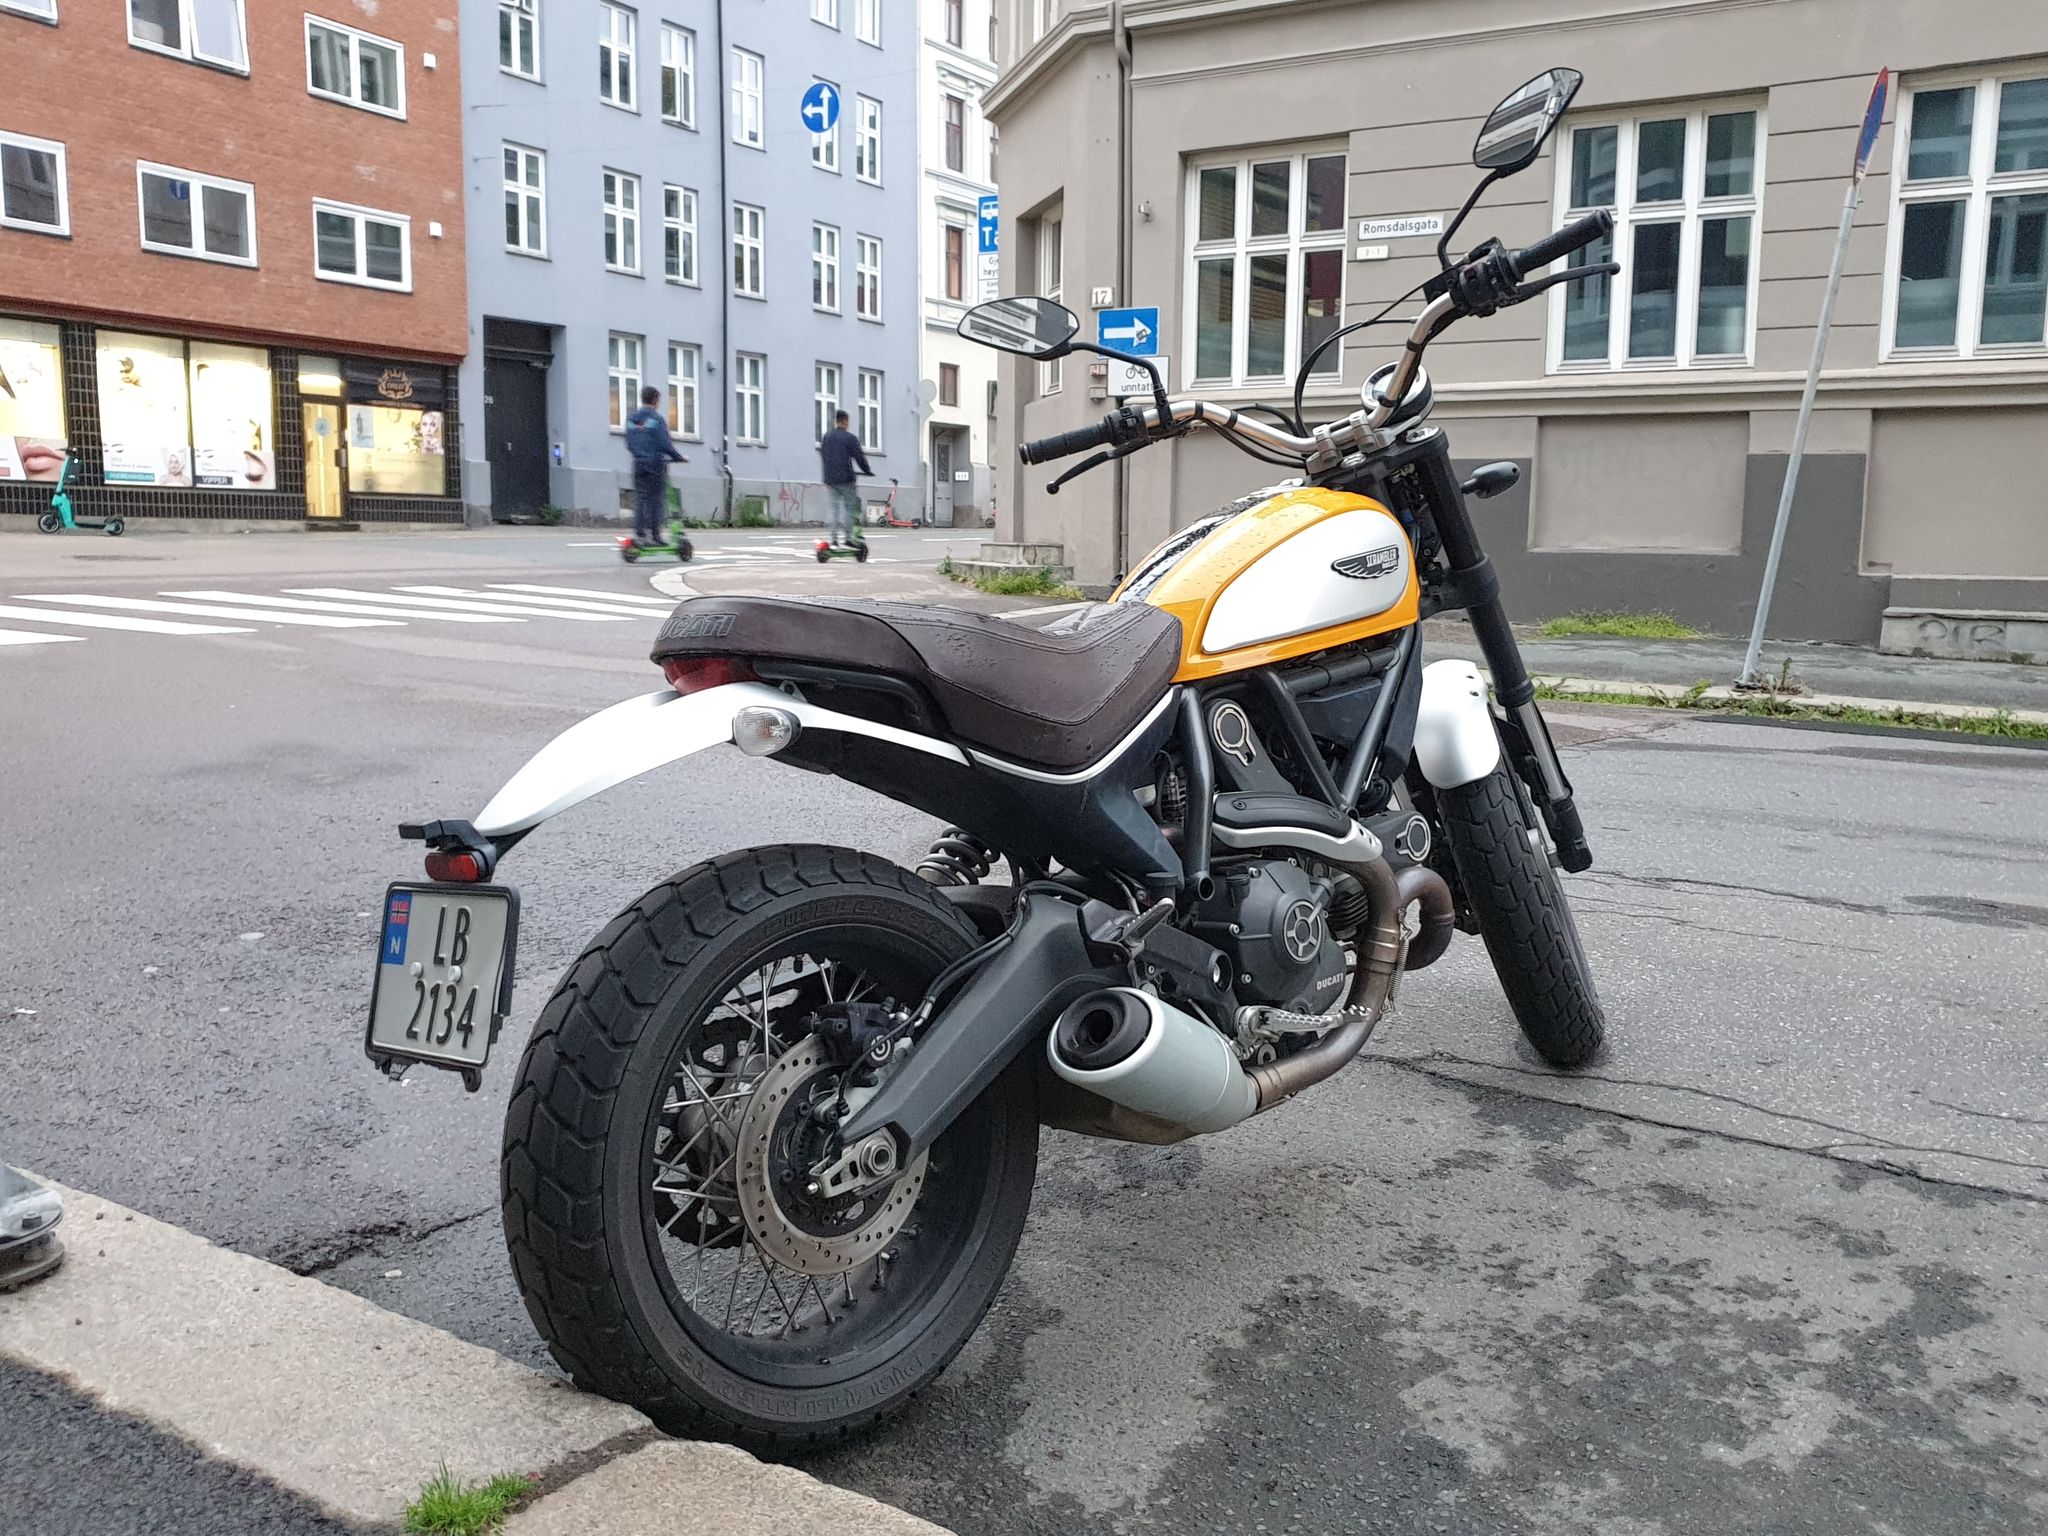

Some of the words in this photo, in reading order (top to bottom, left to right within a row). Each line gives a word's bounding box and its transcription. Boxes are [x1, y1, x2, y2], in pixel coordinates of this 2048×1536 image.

[1363, 219, 1438, 234] Romsdalsgata
[1366, 548, 1397, 567] SCRAMBLER
[658, 613, 738, 641] UCATI
[390, 936, 402, 955] N
[433, 905, 472, 967] LB
[1316, 972, 1344, 991] DUCATI
[406, 979, 480, 1049] 2134
